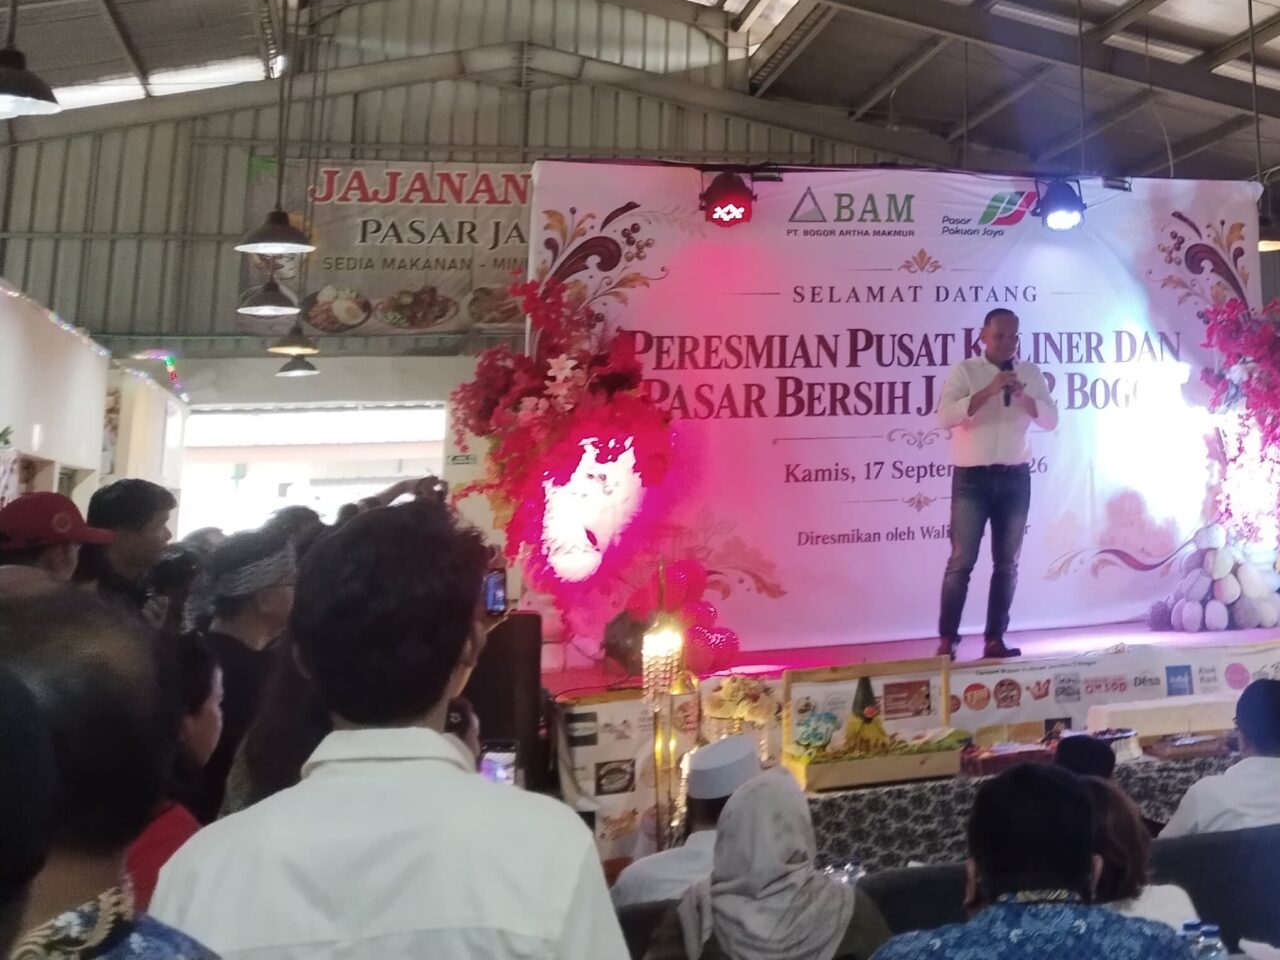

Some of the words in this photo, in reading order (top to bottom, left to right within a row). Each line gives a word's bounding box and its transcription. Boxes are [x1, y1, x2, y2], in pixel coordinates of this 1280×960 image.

[309, 169, 532, 205] JAJANAN
[833, 193, 915, 223] BAM
[942, 216, 972, 226] Pasar
[359, 219, 479, 244] PASAR
[489, 221, 528, 250] JA
[803, 229, 836, 237] BOGOR
[839, 229, 869, 237] ARTHA
[873, 229, 915, 237] MAKMUR
[942, 226, 980, 236] Pakuan
[982, 227, 1004, 239] Jaya
[322, 257, 374, 271] SEDIA
[382, 257, 472, 271] MAKANAN
[792, 286, 923, 303] SELAMAT
[934, 285, 1037, 303] DATANG
[629, 329, 839, 371] PERESMIAN
[846, 328, 955, 368] PUSAT
[961, 327, 1105, 365] KLINER
[1113, 330, 1181, 363] DAN
[641, 378, 768, 420] PASAR
[773, 376, 911, 417] BERSIH
[784, 463, 856, 483] Kamis,
[864, 461, 884, 480] 17
[797, 528, 881, 546] Diresmikan
[886, 526, 915, 541] oleh
